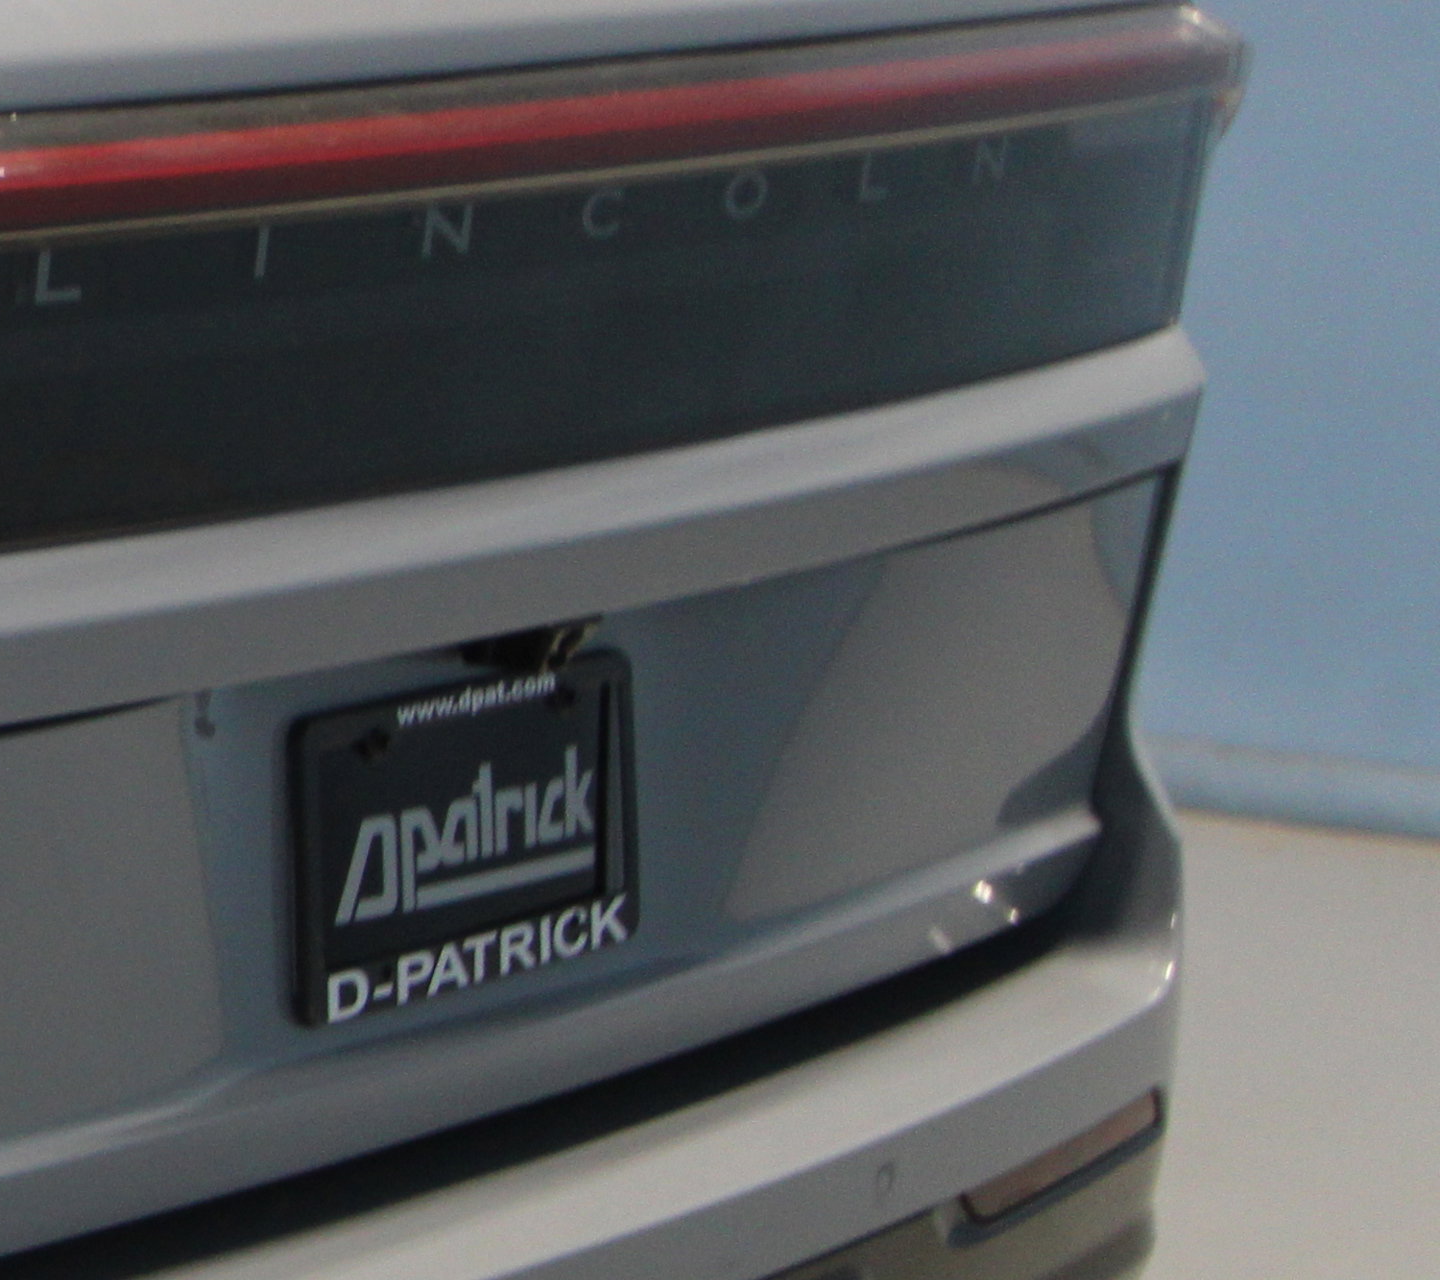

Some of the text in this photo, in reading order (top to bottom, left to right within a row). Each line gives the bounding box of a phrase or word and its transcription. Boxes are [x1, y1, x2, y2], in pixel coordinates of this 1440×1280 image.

[35, 136, 1008, 305] LINCOLN
[396, 673, 556, 725] www.dpat.com
[326, 894, 630, 1023] D-PATRICK
